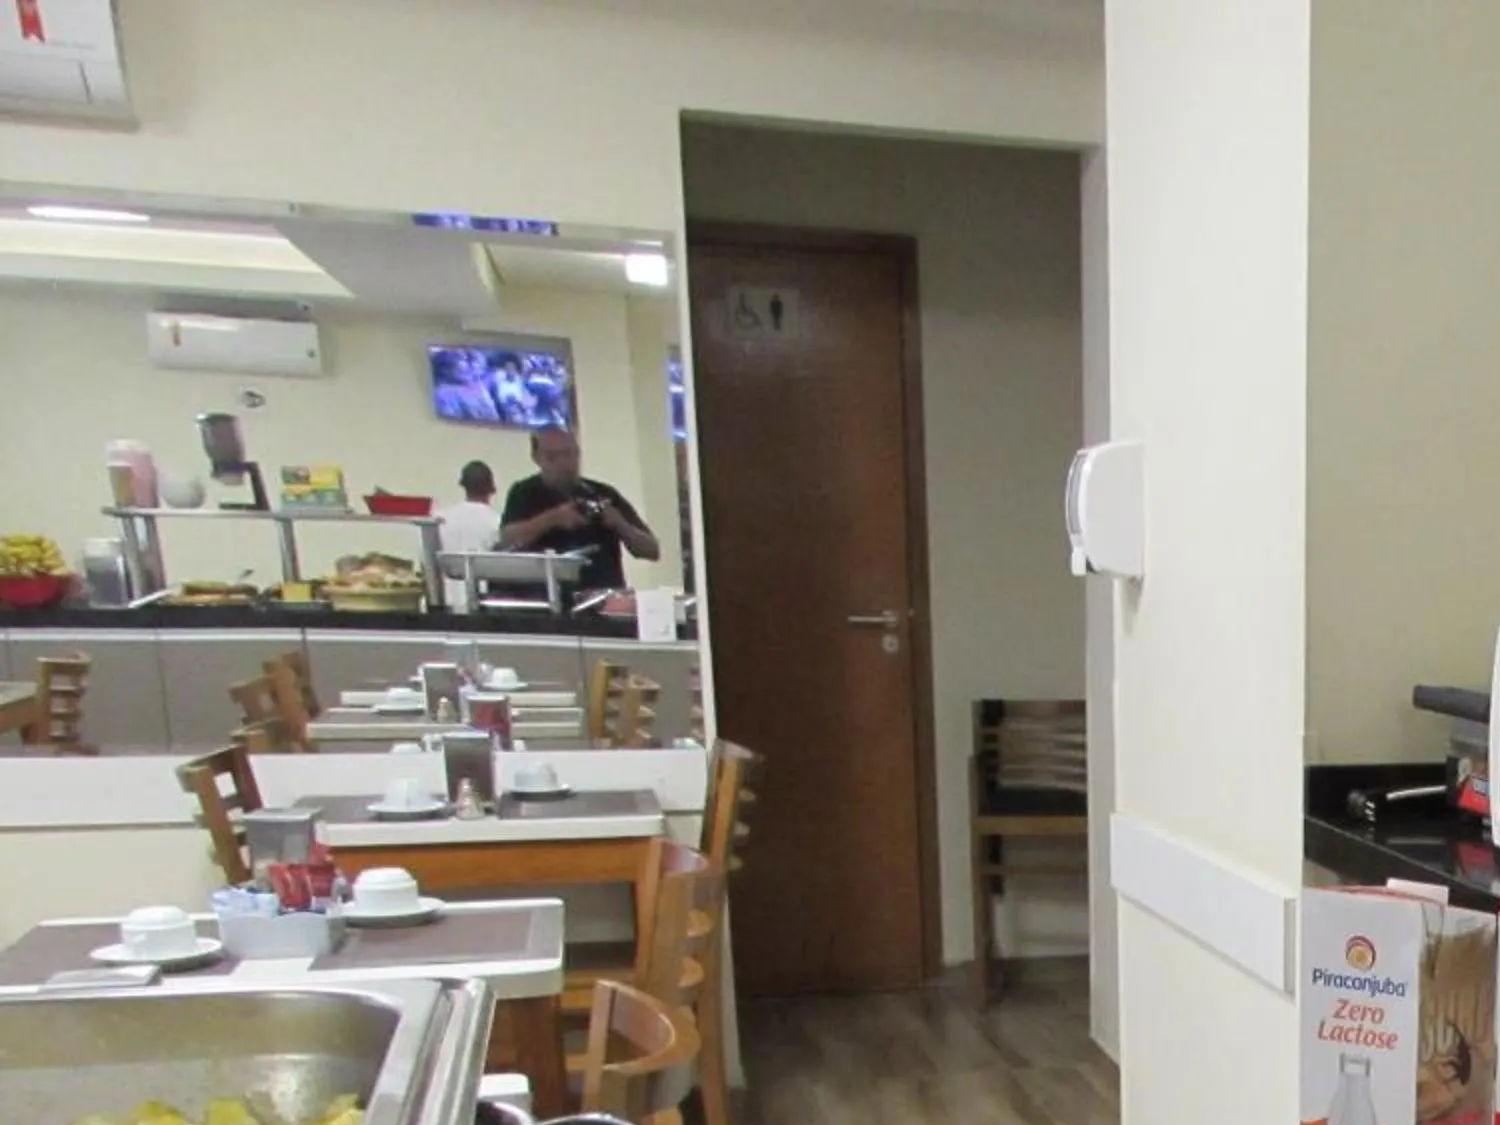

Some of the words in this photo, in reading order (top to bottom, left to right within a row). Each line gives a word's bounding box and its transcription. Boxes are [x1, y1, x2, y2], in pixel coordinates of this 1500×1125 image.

[1311, 967, 1406, 998] Piracanjuba
[1333, 998, 1385, 1024] Zero
[1318, 1018, 1399, 1050] Lactose
